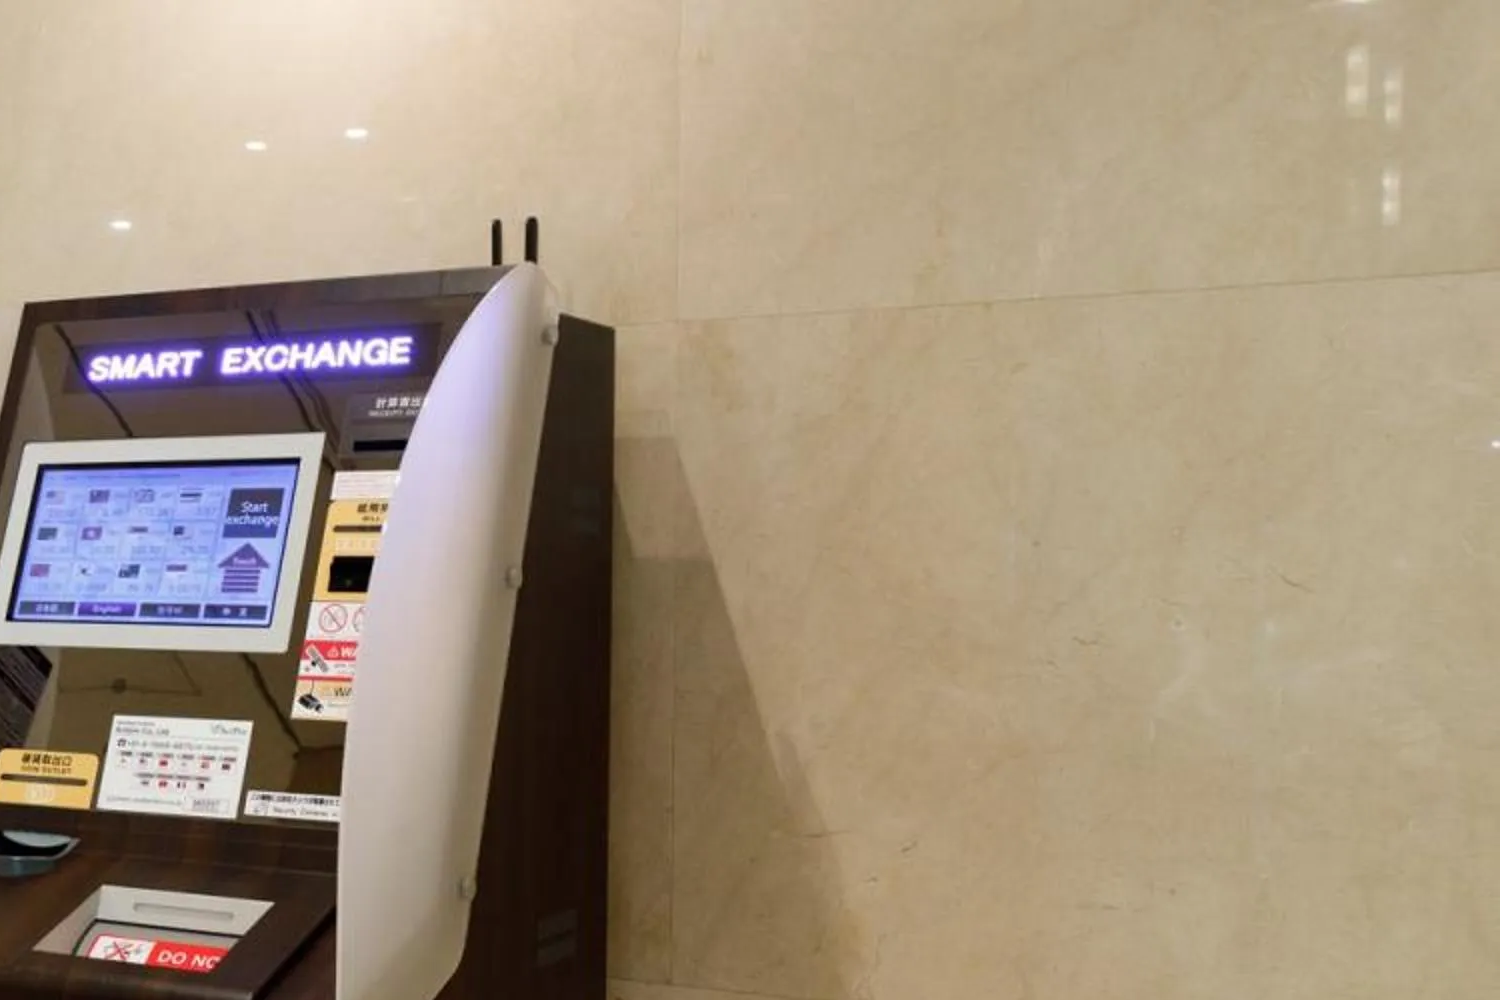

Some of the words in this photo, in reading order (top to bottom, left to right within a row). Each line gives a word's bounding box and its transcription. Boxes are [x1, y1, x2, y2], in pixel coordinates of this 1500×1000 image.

[88, 351, 202, 382] SMART
[220, 336, 413, 375] EXCHANGE
[241, 501, 268, 513] Start
[227, 515, 279, 528] exchange
[157, 950, 187, 965] DO
